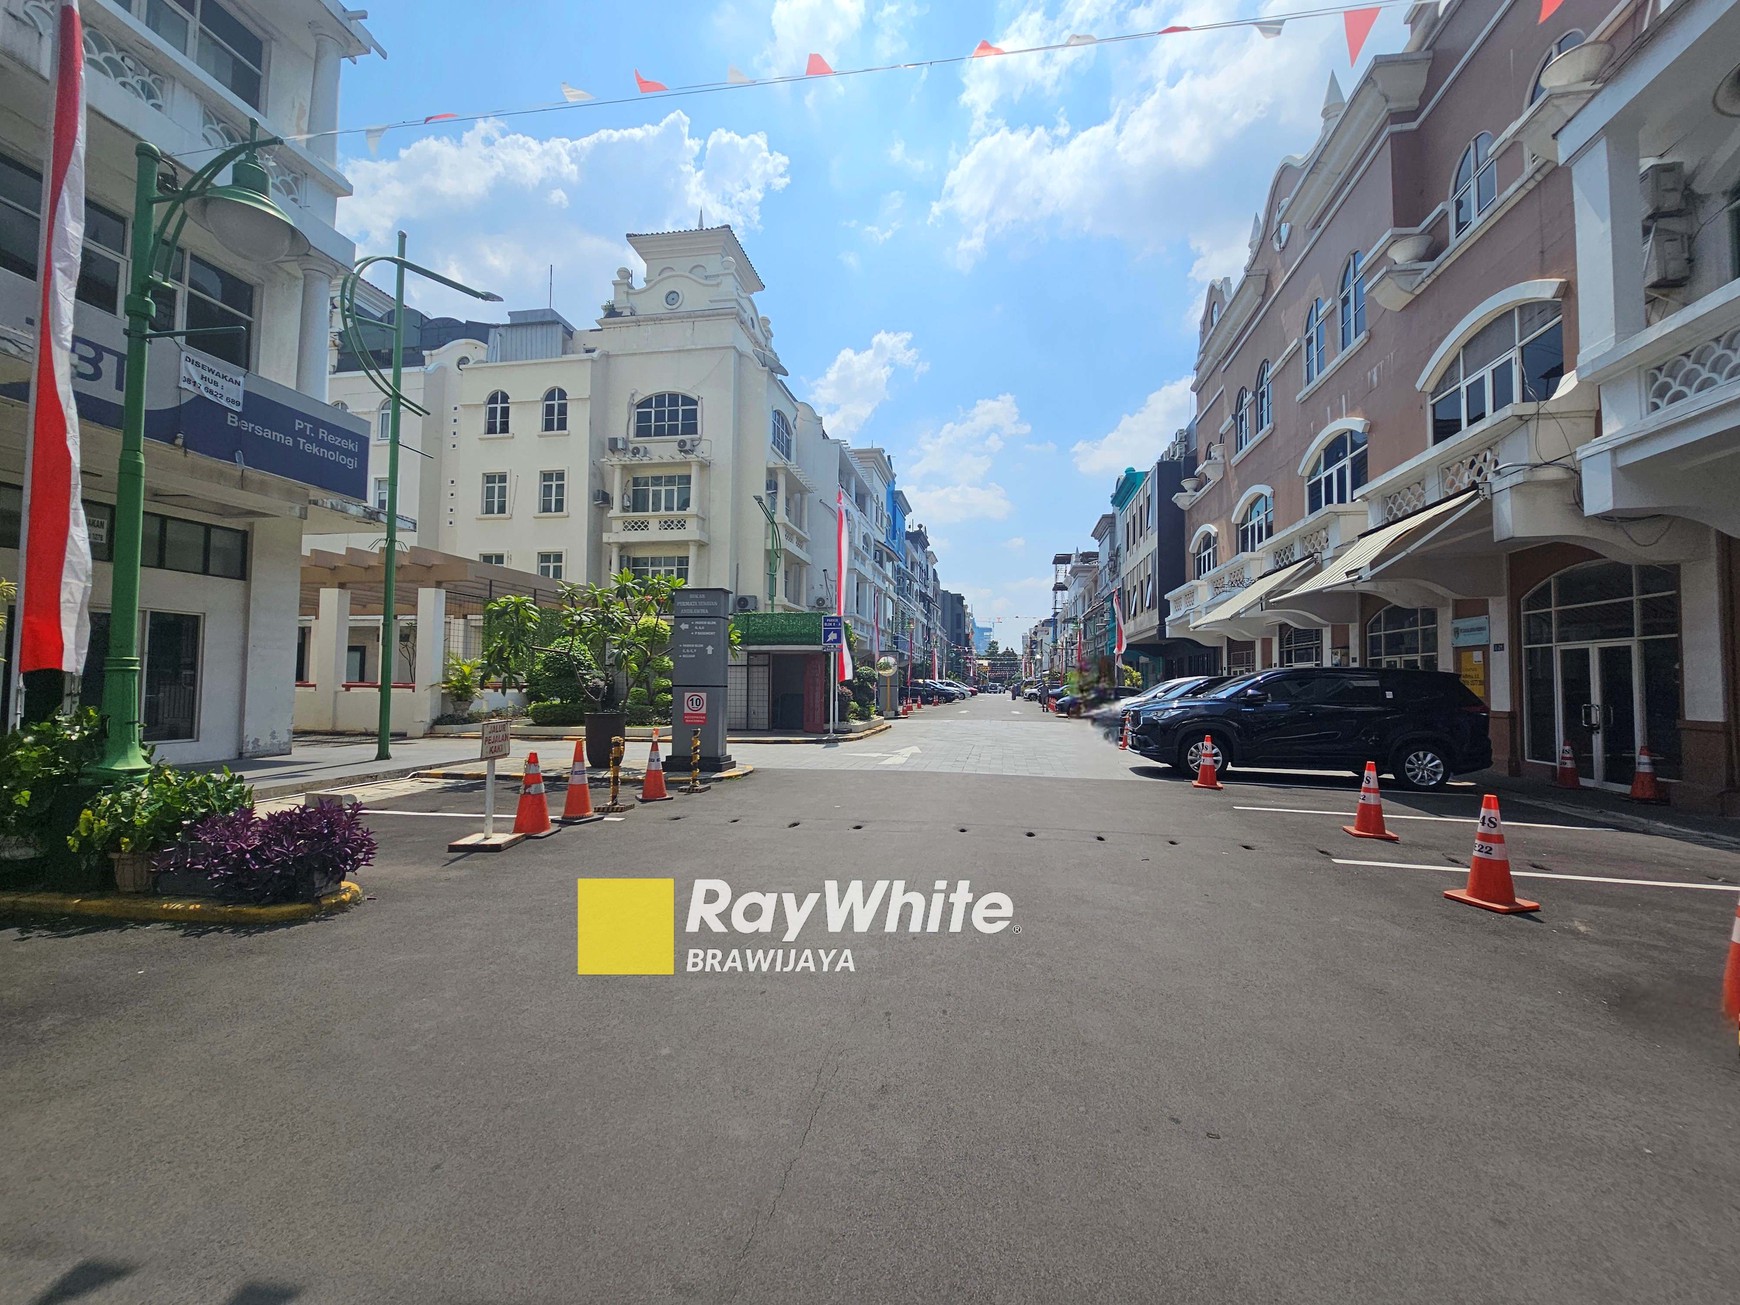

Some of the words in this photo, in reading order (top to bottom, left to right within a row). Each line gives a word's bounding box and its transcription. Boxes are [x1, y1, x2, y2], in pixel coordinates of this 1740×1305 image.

[185, 355, 241, 387] DISEWAKAN
[225, 396, 241, 407] 689
[226, 412, 293, 447] Bersama
[297, 437, 358, 470] Teknologi
[294, 419, 315, 437] PT.
[319, 428, 358, 453] Rezeki
[690, 697, 702, 707] 10
[488, 723, 507, 733] JALUR
[484, 733, 509, 745] PEJALAN
[1480, 815, 1498, 829] 4S
